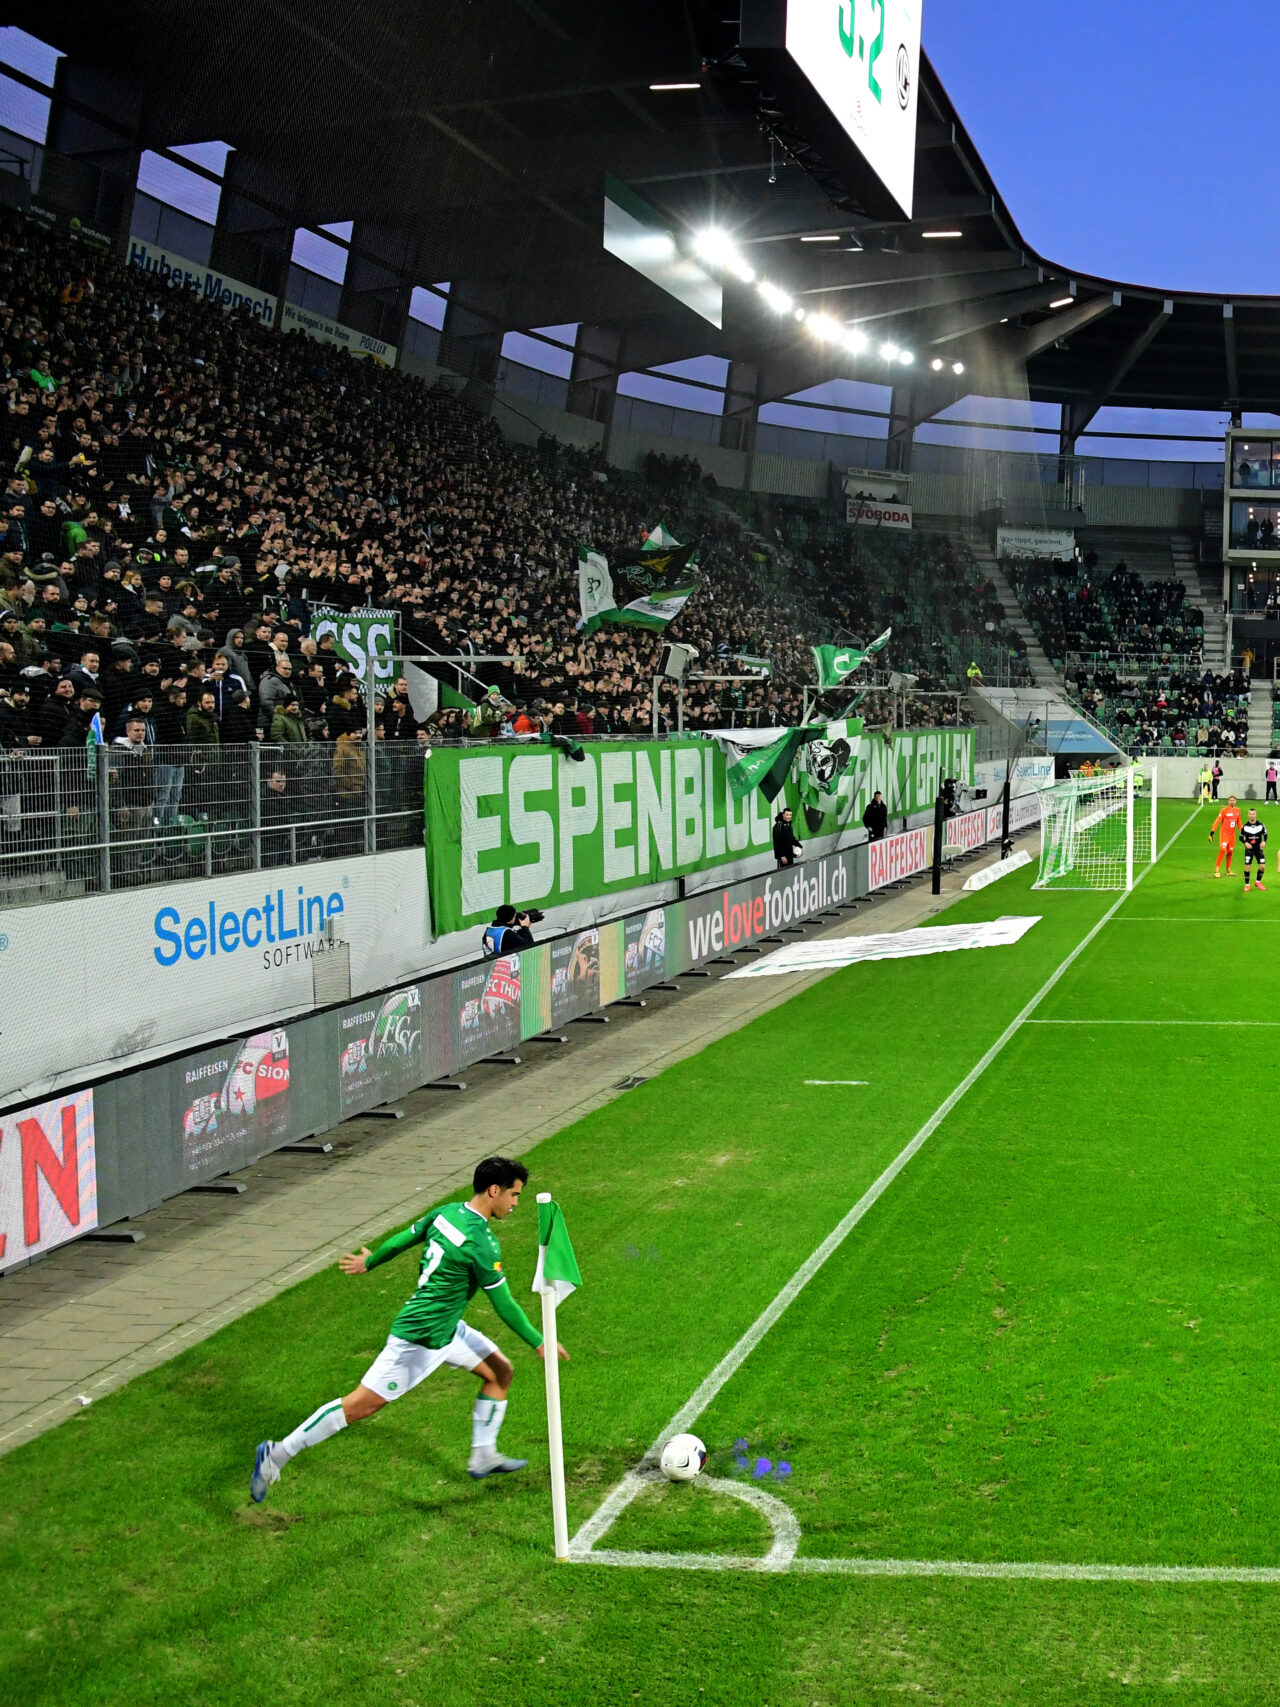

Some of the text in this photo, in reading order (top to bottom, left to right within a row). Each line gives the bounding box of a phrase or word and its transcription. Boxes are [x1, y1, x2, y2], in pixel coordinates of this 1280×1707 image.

[360, 335, 388, 355] POLLUX
[848, 507, 910, 523] SVOBODA
[309, 619, 394, 680] CSG
[948, 812, 986, 851] RAIFFEISEN
[870, 831, 925, 888] RAIFFEISEN
[688, 855, 848, 961] welovefootball.ch
[185, 1059, 229, 1084] RAIFFEISEN
